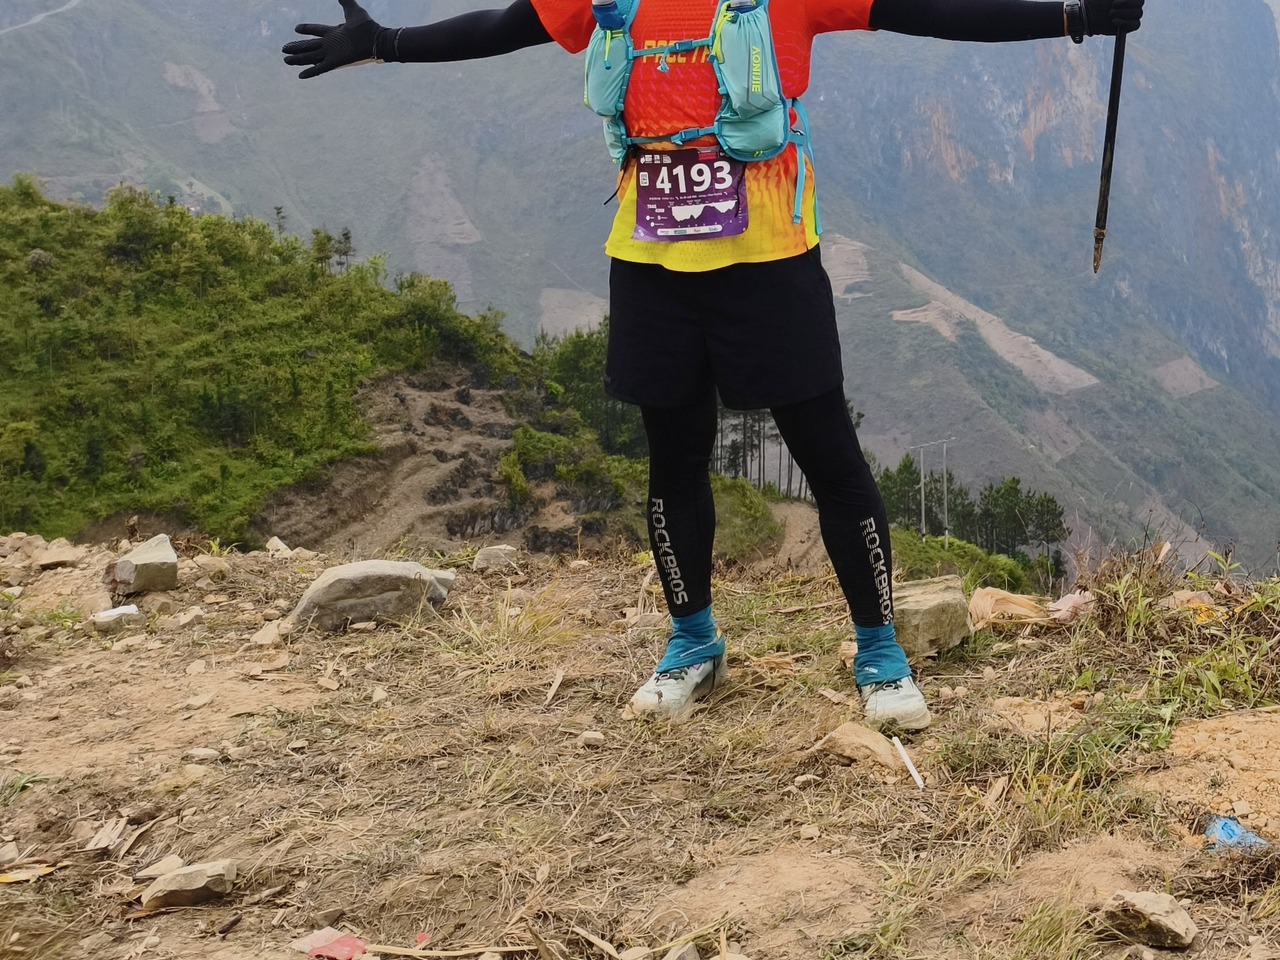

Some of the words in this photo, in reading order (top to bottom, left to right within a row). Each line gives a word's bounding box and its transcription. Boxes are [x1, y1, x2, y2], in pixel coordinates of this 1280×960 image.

[655, 160, 733, 195] 4193
[651, 497, 689, 605] ROCKBROS
[859, 516, 894, 625] ROCKBROS
